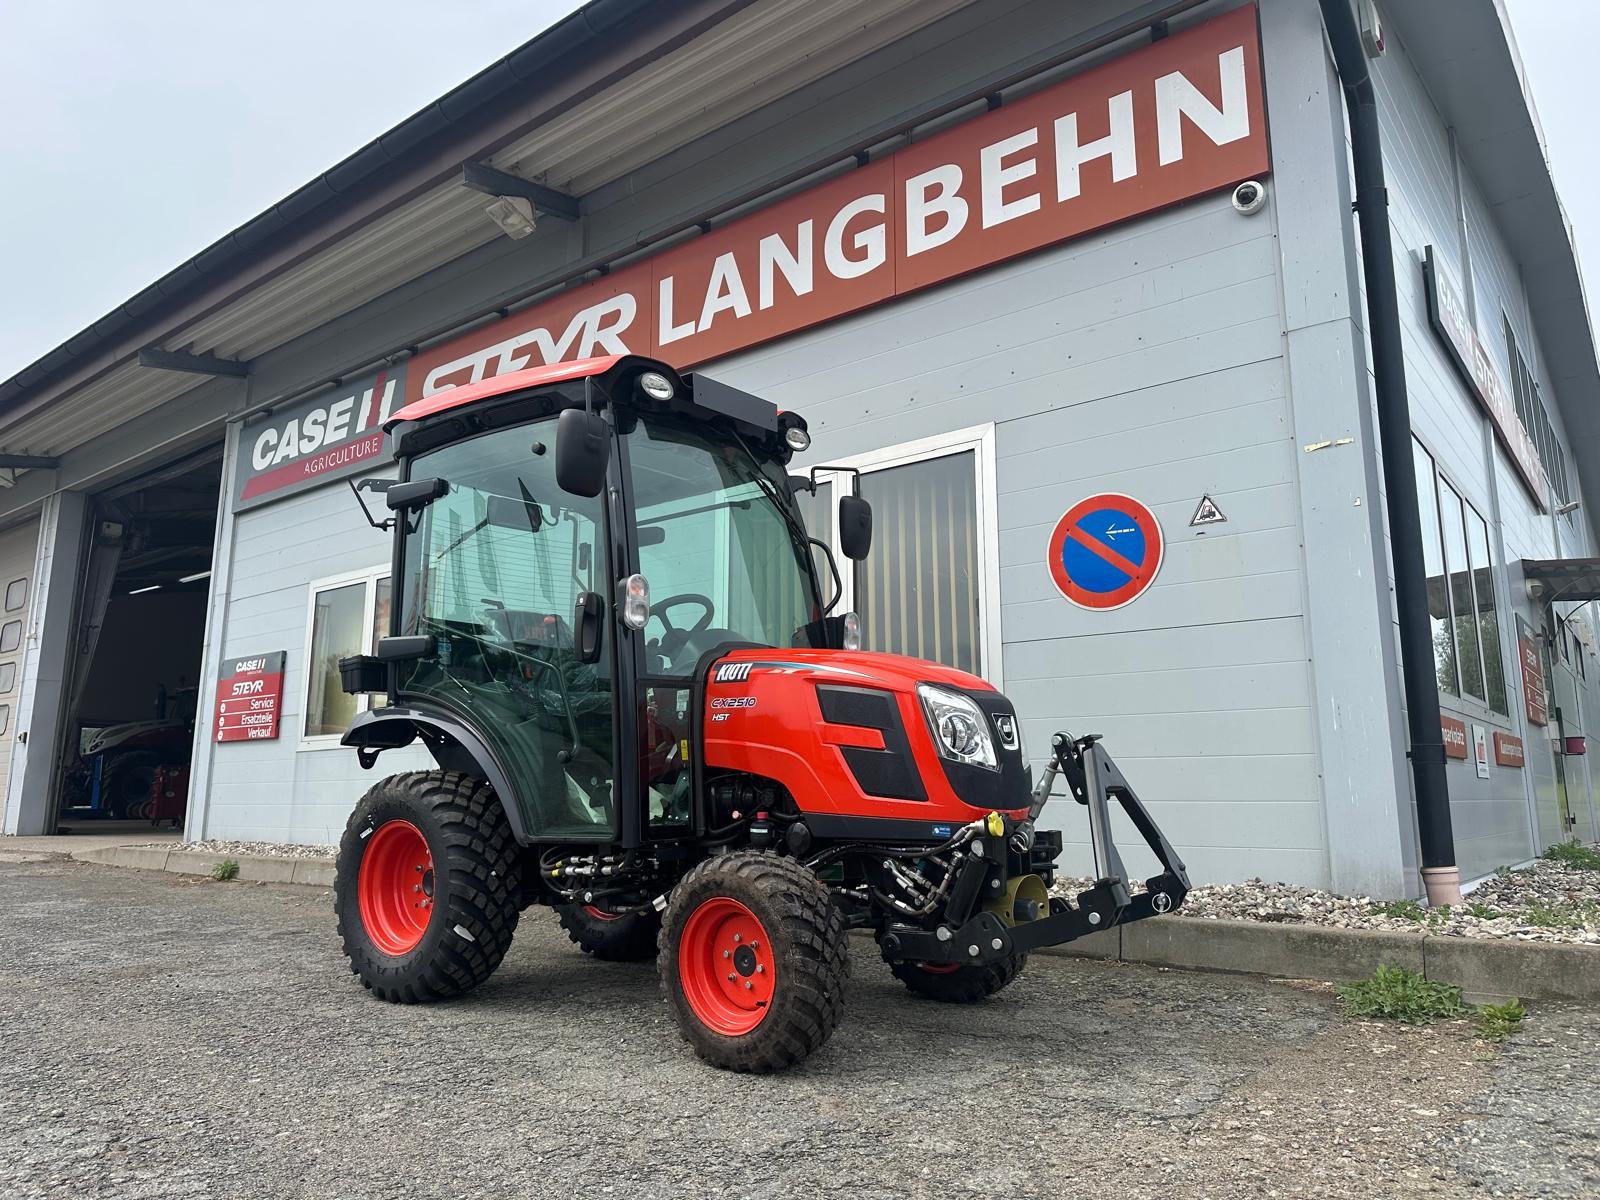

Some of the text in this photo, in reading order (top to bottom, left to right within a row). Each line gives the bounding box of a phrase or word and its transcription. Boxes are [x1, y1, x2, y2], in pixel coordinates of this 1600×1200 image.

[658, 45, 1250, 346] LANGBEHN
[422, 292, 637, 399] STEYR
[252, 395, 355, 472] CASE
[303, 437, 379, 475] AGRICULTURE
[236, 660, 258, 672] CASE
[716, 663, 754, 681] KIOTI
[232, 680, 264, 695] STEYR
[250, 698, 273, 709] Service
[711, 697, 757, 709] CX2510
[241, 712, 272, 725] Ersatzteile
[711, 713, 731, 721] HST
[248, 726, 272, 738] Verkauf
